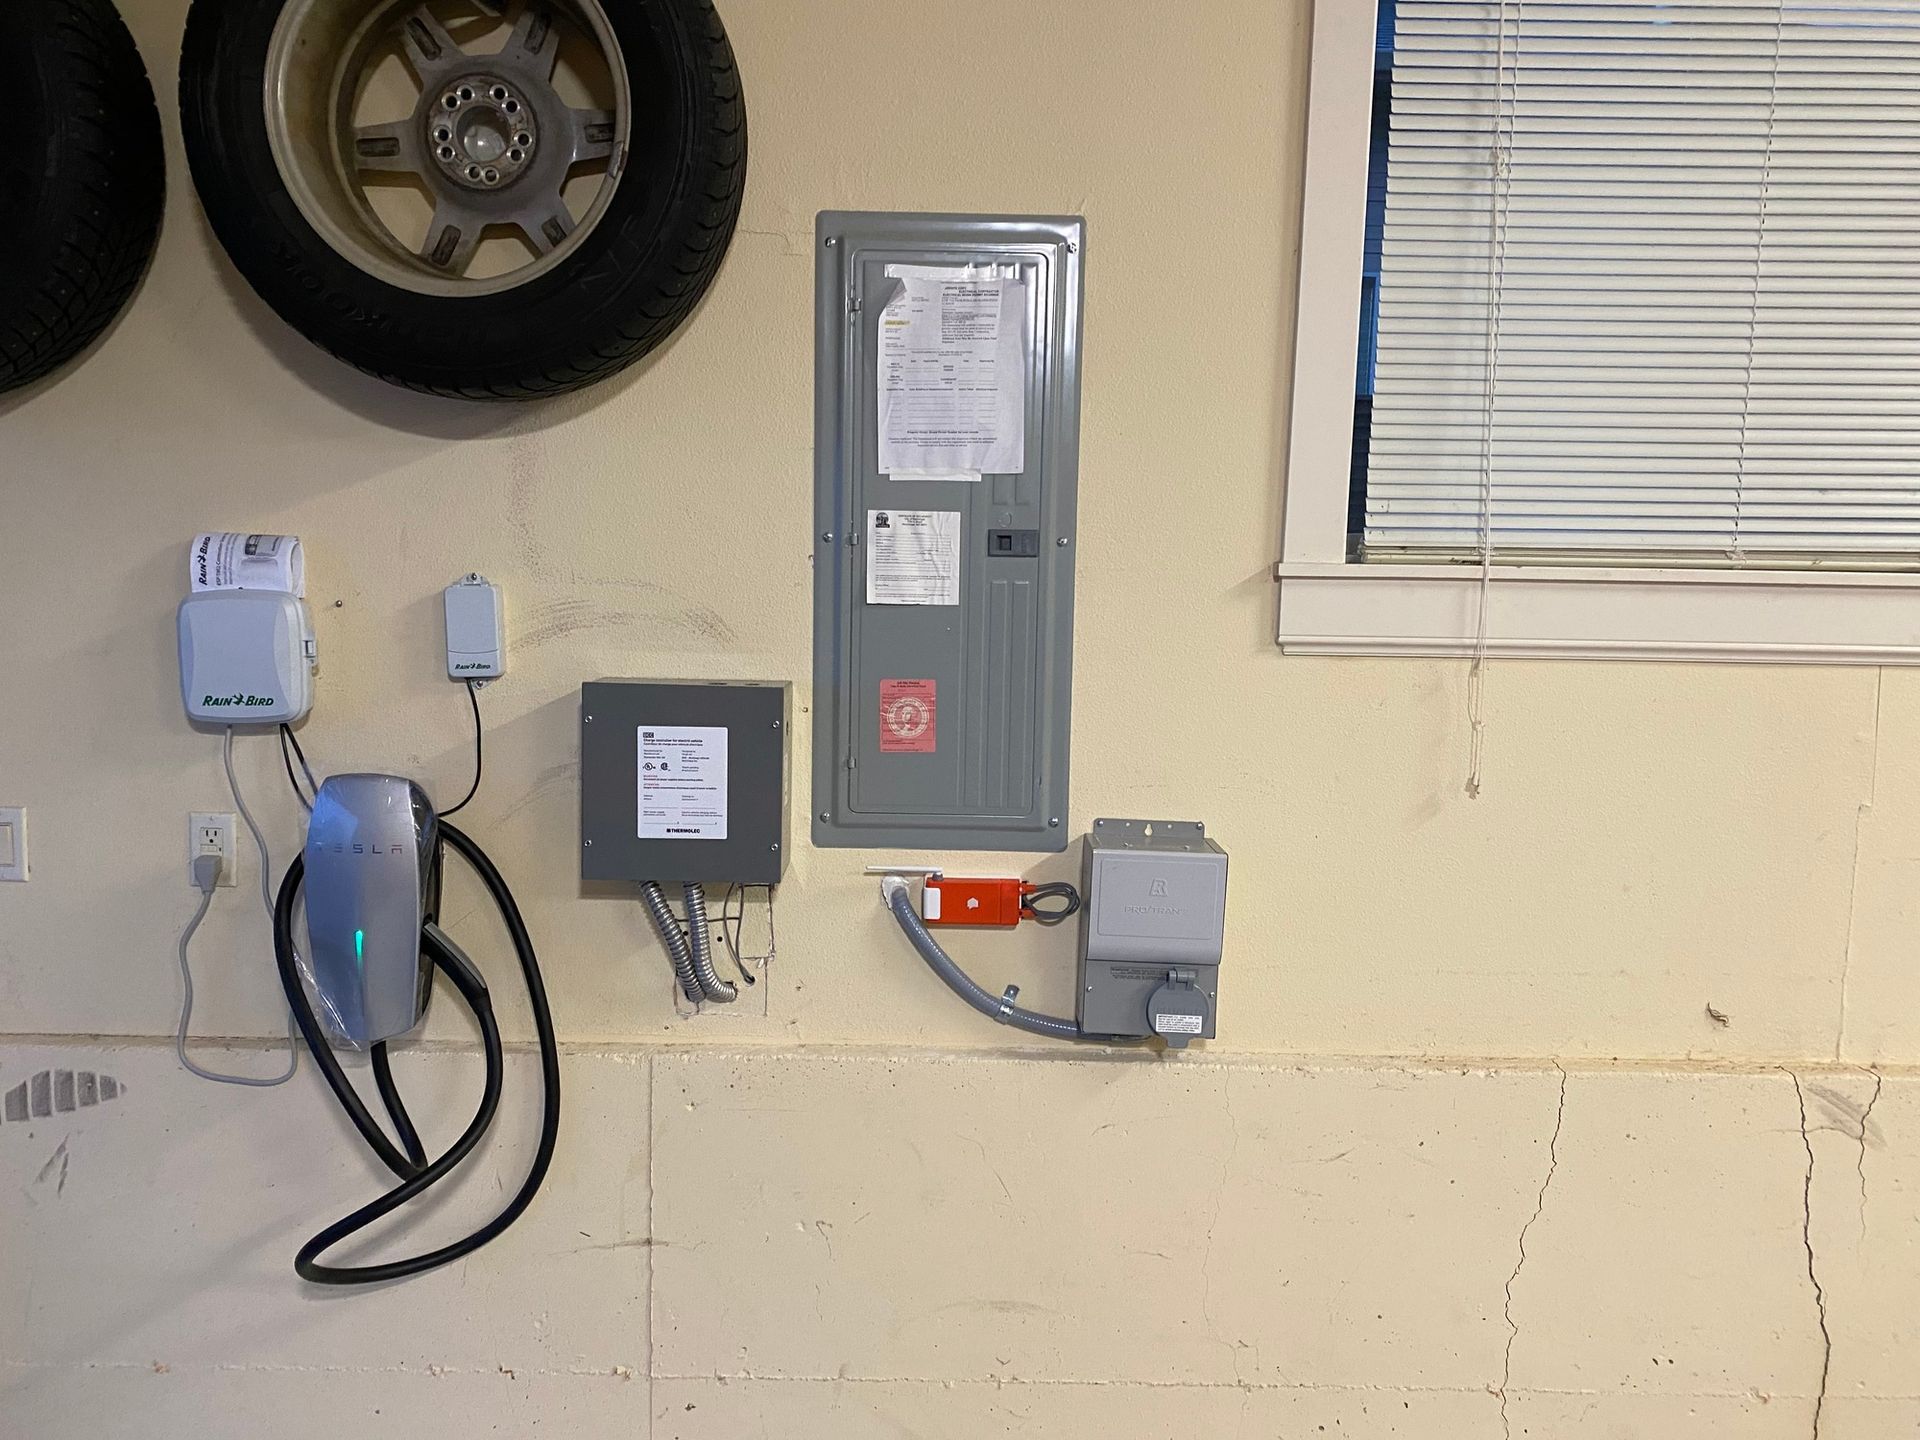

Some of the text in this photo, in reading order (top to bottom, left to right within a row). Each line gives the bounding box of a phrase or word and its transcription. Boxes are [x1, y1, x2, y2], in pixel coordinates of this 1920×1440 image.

[199, 537, 211, 586] RAIN BIRD
[202, 695, 274, 706] RAIN BIRD
[314, 843, 403, 854] ESLA
